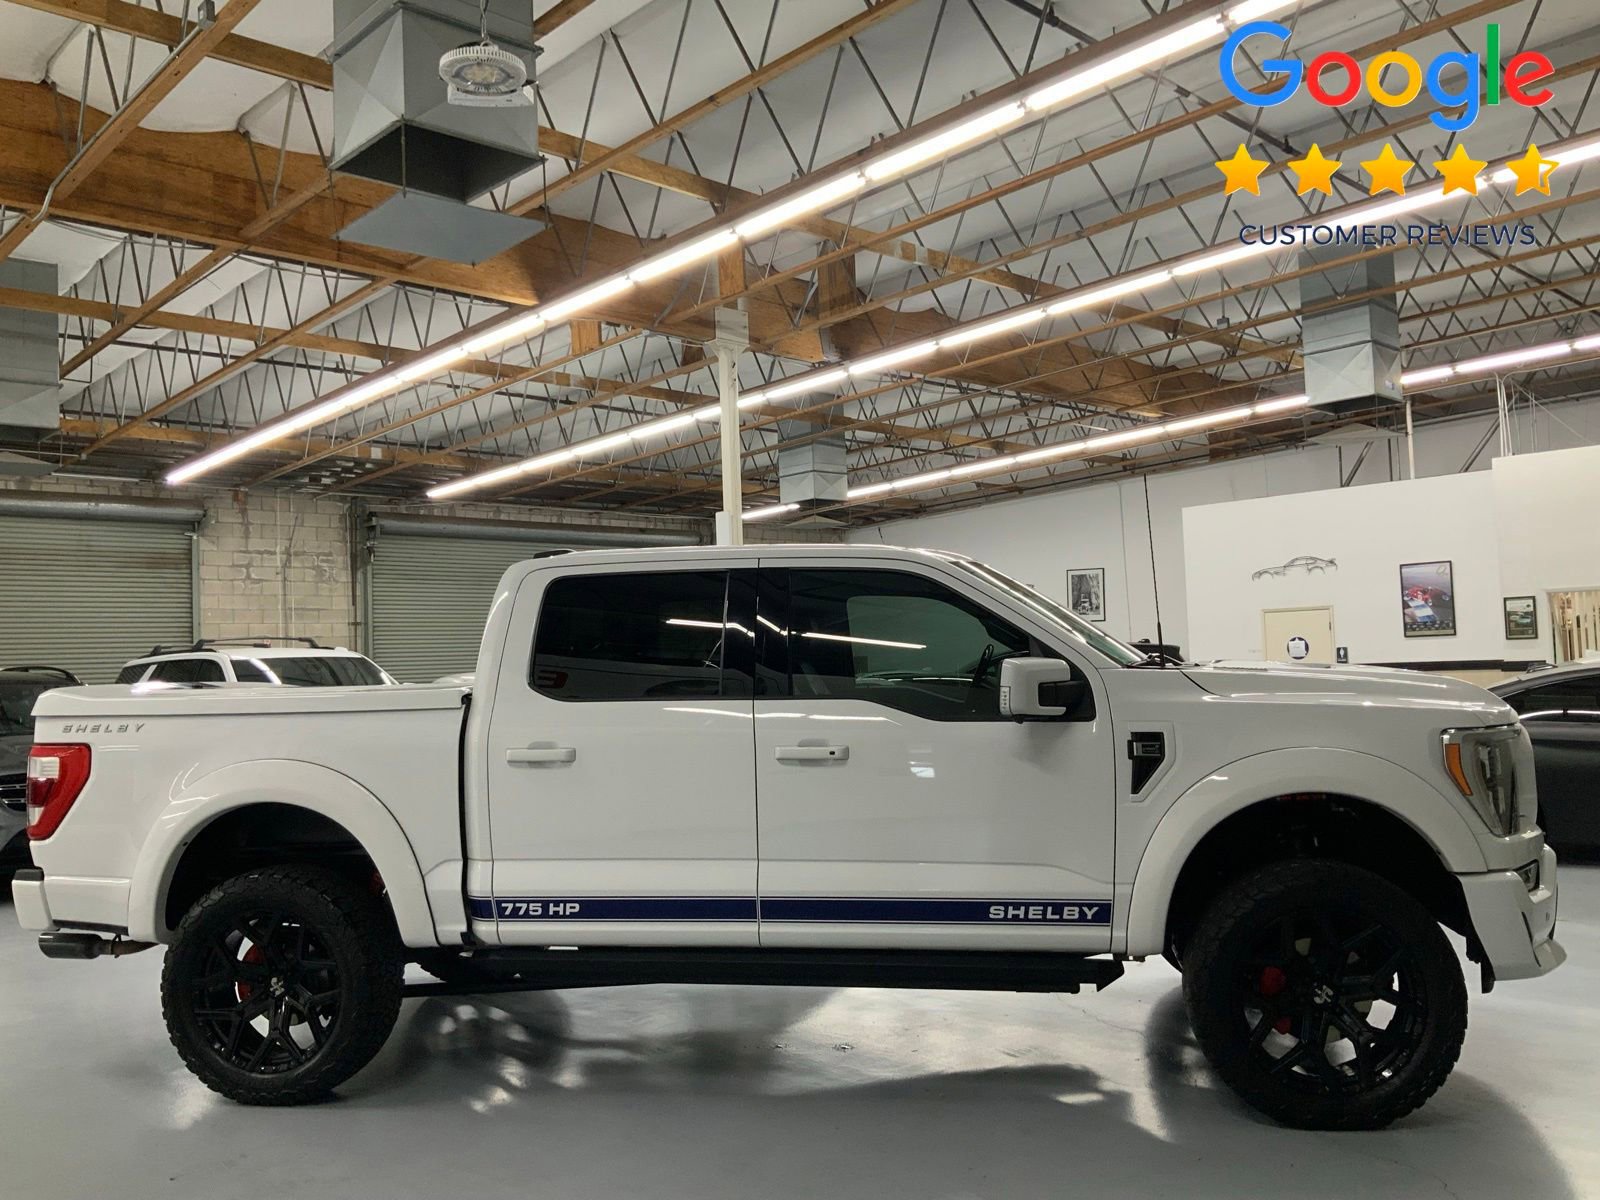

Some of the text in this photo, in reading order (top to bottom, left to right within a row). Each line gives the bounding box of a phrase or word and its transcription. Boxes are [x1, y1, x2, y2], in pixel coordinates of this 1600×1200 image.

[62, 722, 147, 734] SHELBY
[501, 902, 580, 916] 775 HP
[988, 905, 1100, 920] SHELBY
